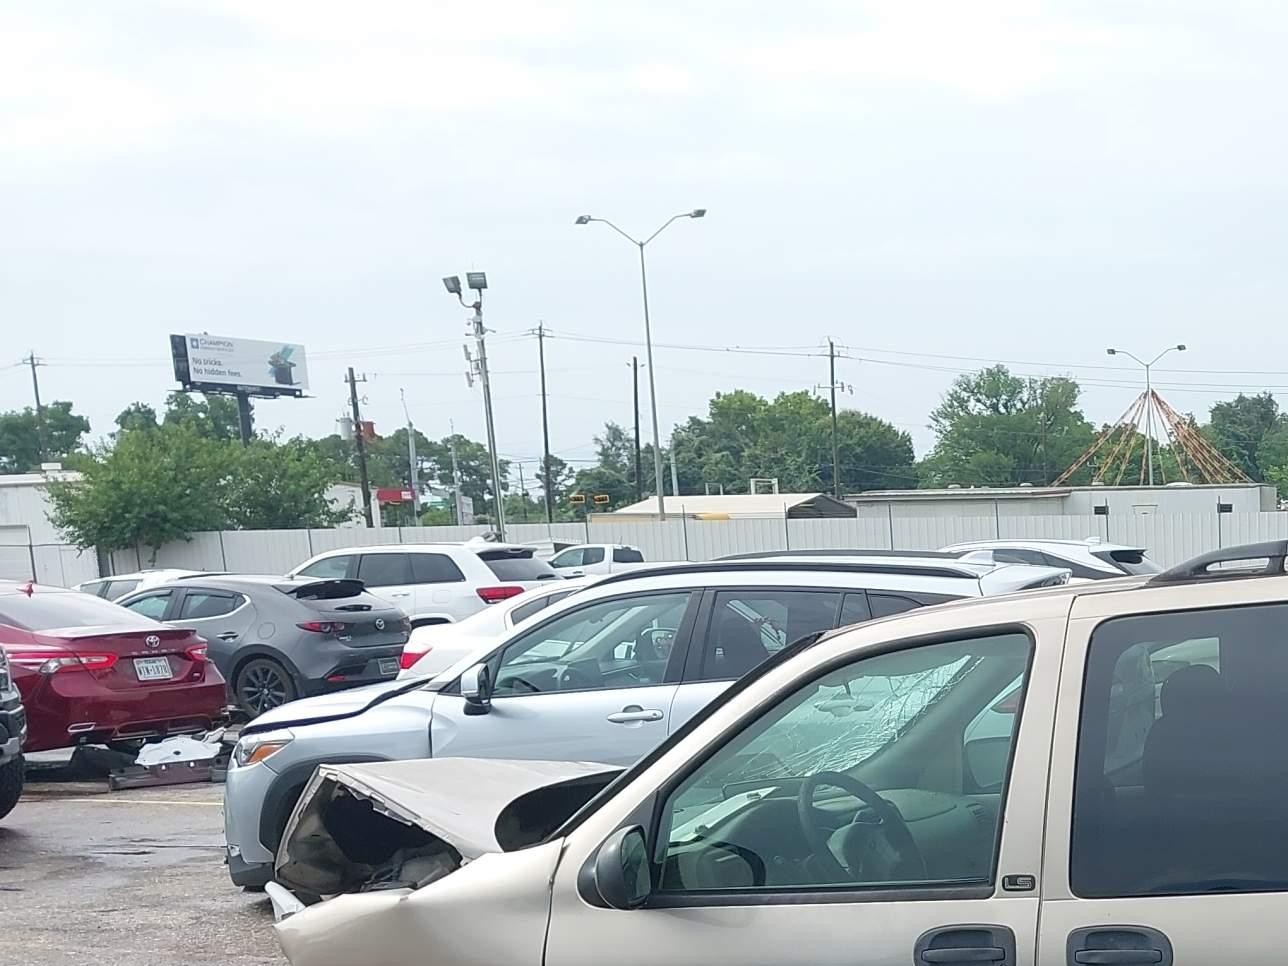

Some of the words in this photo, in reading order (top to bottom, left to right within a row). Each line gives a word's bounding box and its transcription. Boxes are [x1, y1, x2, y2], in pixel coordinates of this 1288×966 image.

[192, 357, 202, 366] No
[193, 367, 203, 375] No
[204, 367, 227, 376] hidden
[1004, 877, 1032, 889] LS
